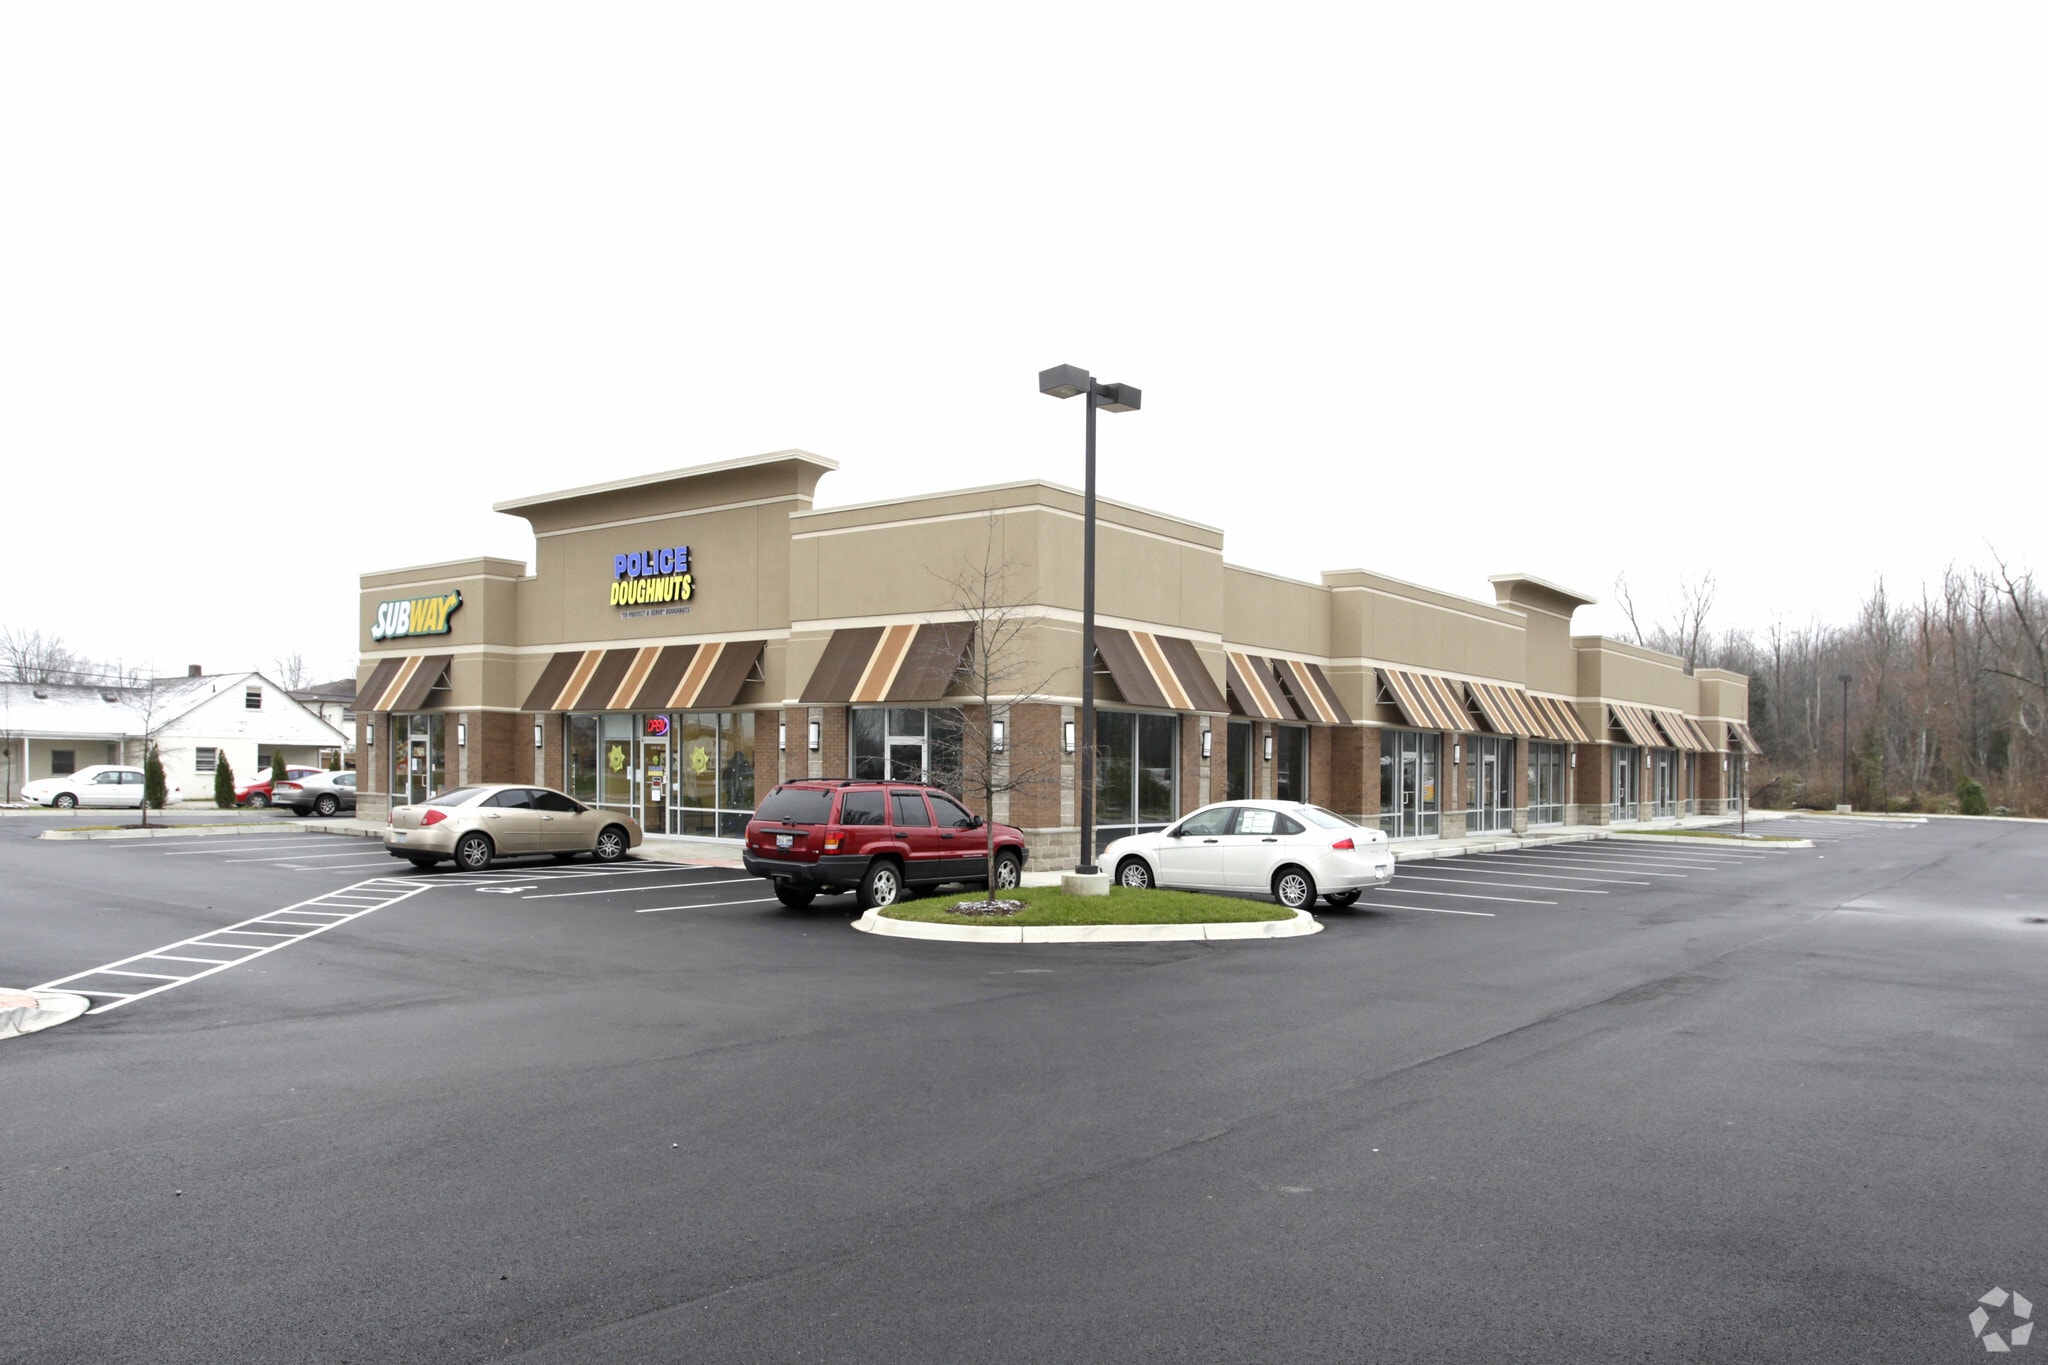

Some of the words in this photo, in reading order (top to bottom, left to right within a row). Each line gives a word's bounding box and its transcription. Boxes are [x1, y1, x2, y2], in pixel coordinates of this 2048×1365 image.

[614, 546, 688, 579] POLICE
[610, 574, 692, 606] DOUGHNUTS
[371, 593, 457, 637] SUBWAY
[665, 607, 690, 615] DOUGHNUTS
[647, 719, 665, 732] OPEN
